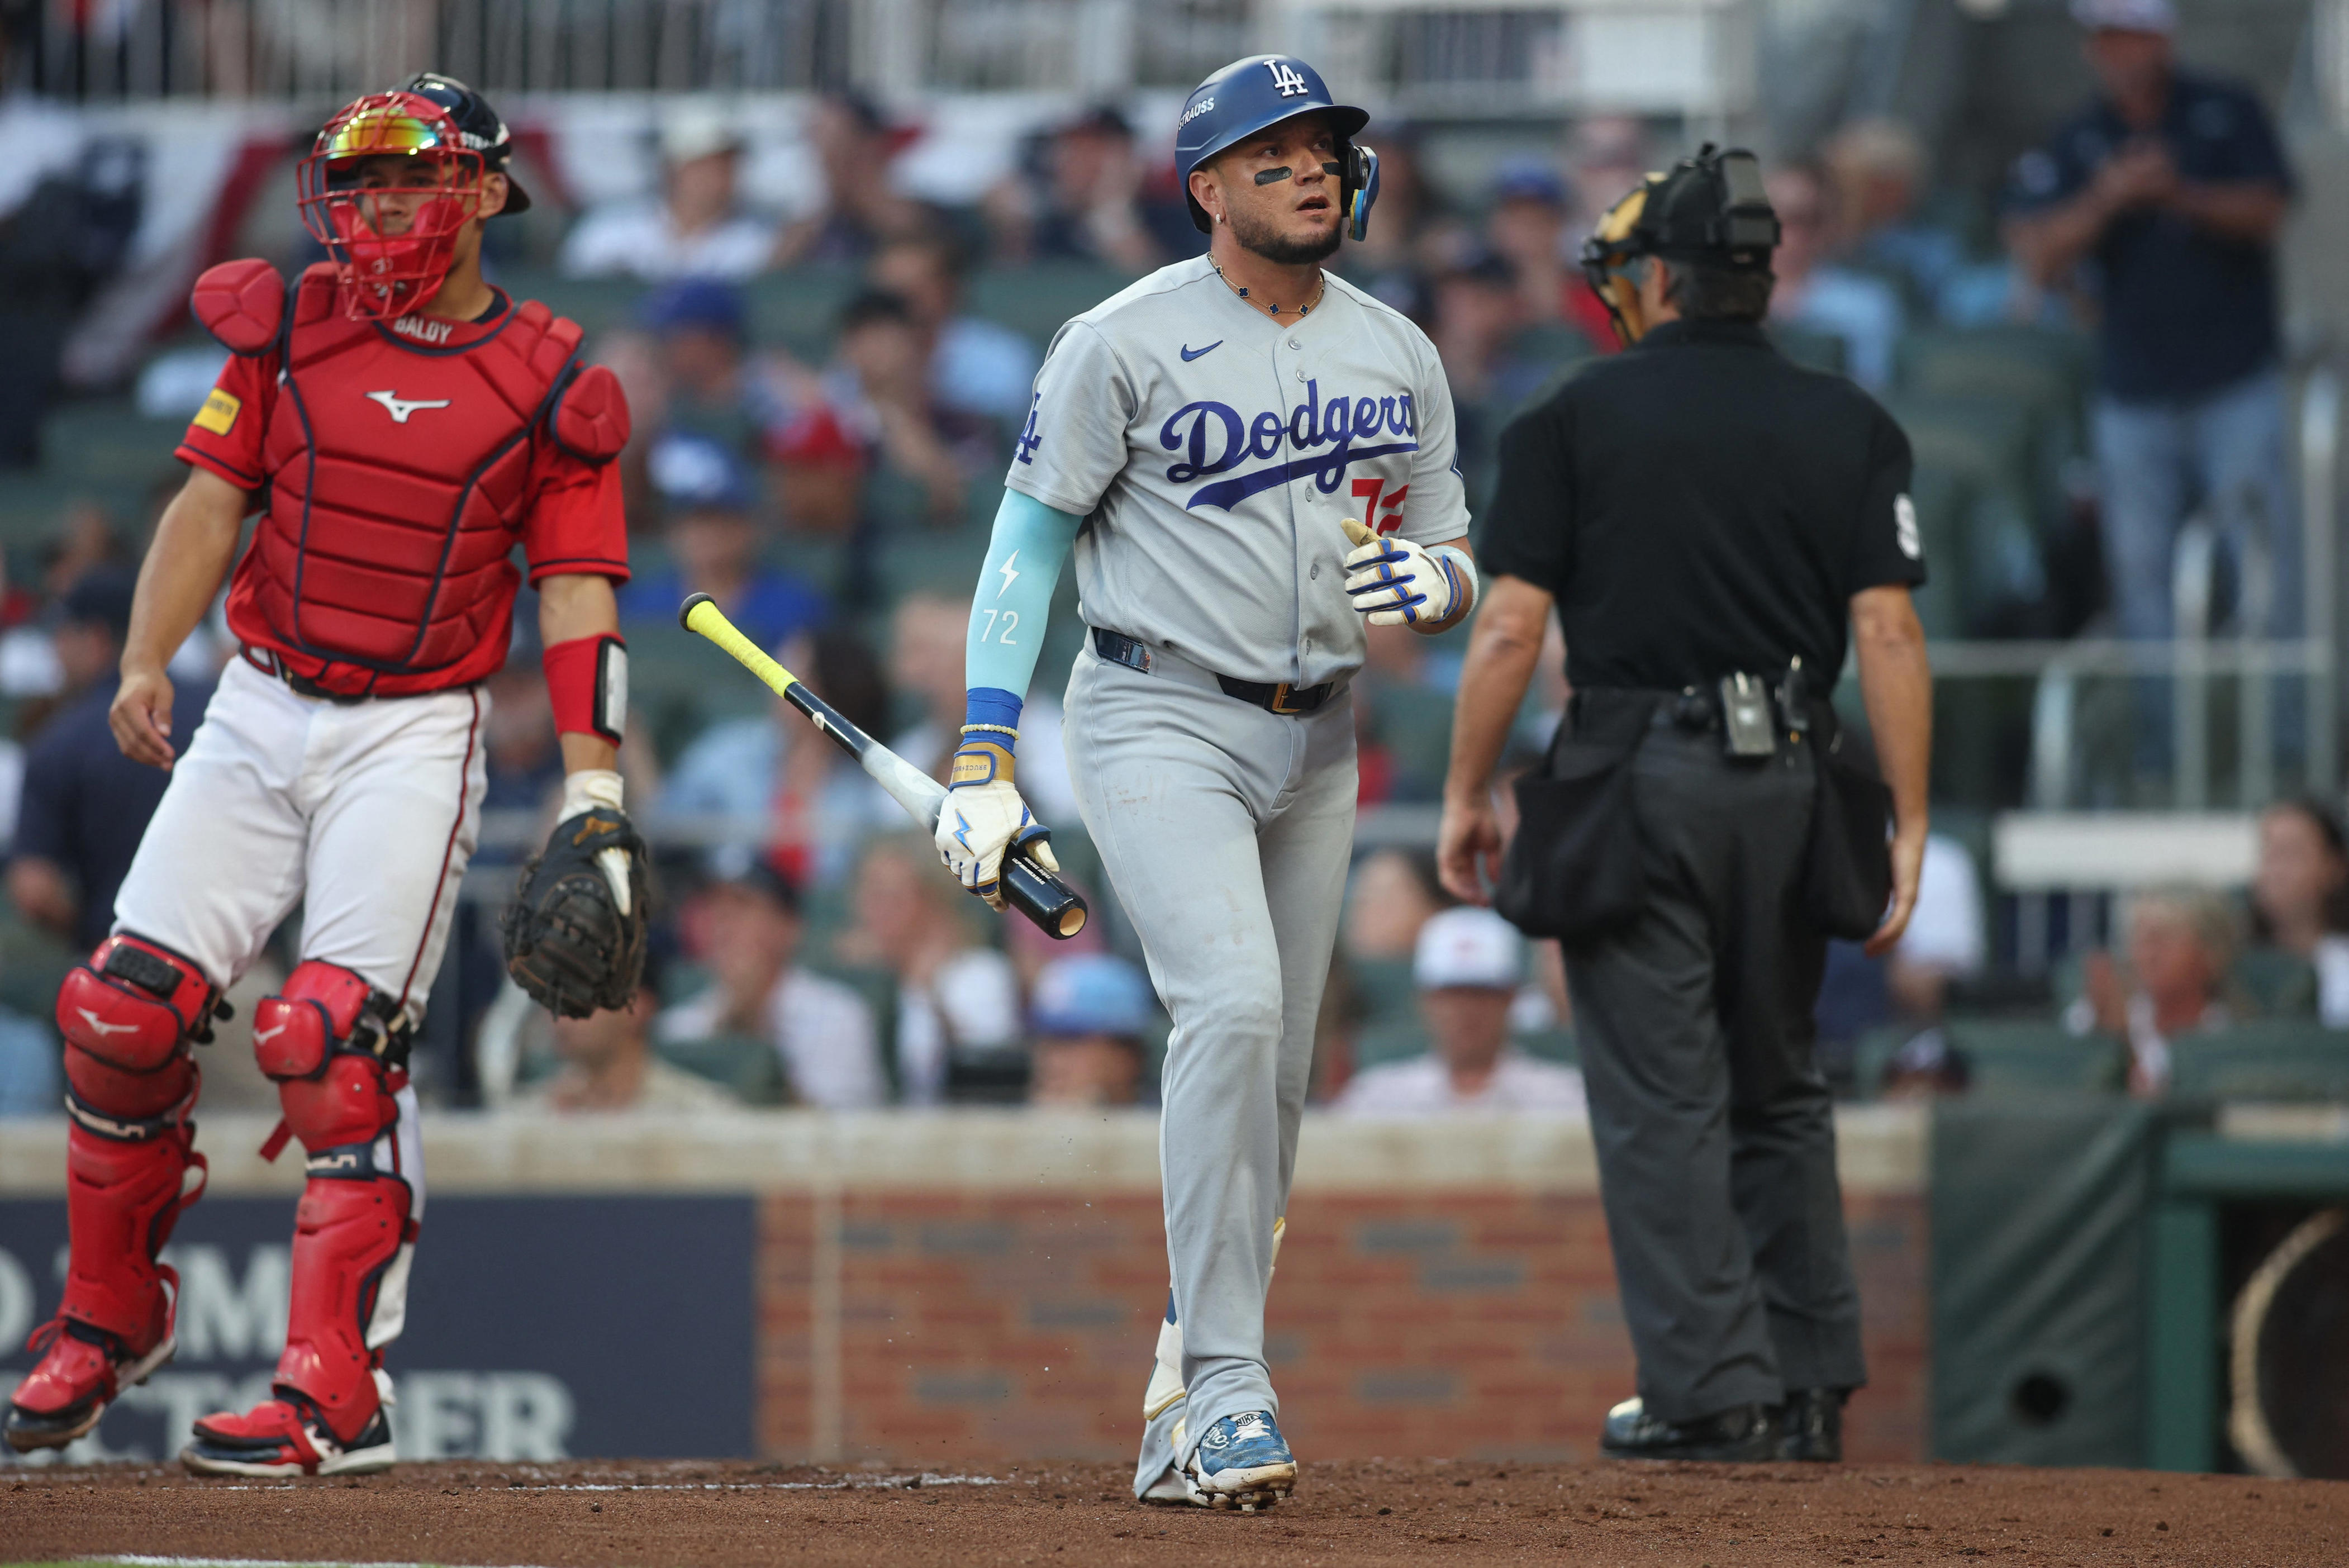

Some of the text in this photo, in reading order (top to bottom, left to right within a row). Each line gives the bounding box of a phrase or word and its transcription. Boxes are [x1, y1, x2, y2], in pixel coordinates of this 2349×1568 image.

[1263, 59, 1309, 97] LA
[1178, 97, 1215, 131] STRAUSS
[1160, 379, 1414, 494] Dodgers
[981, 609, 1019, 645] 72
[1023, 857, 1039, 869] MIGUEL
[1038, 868, 1052, 879] ROJAS
[1236, 1415, 1256, 1426] NIKE
